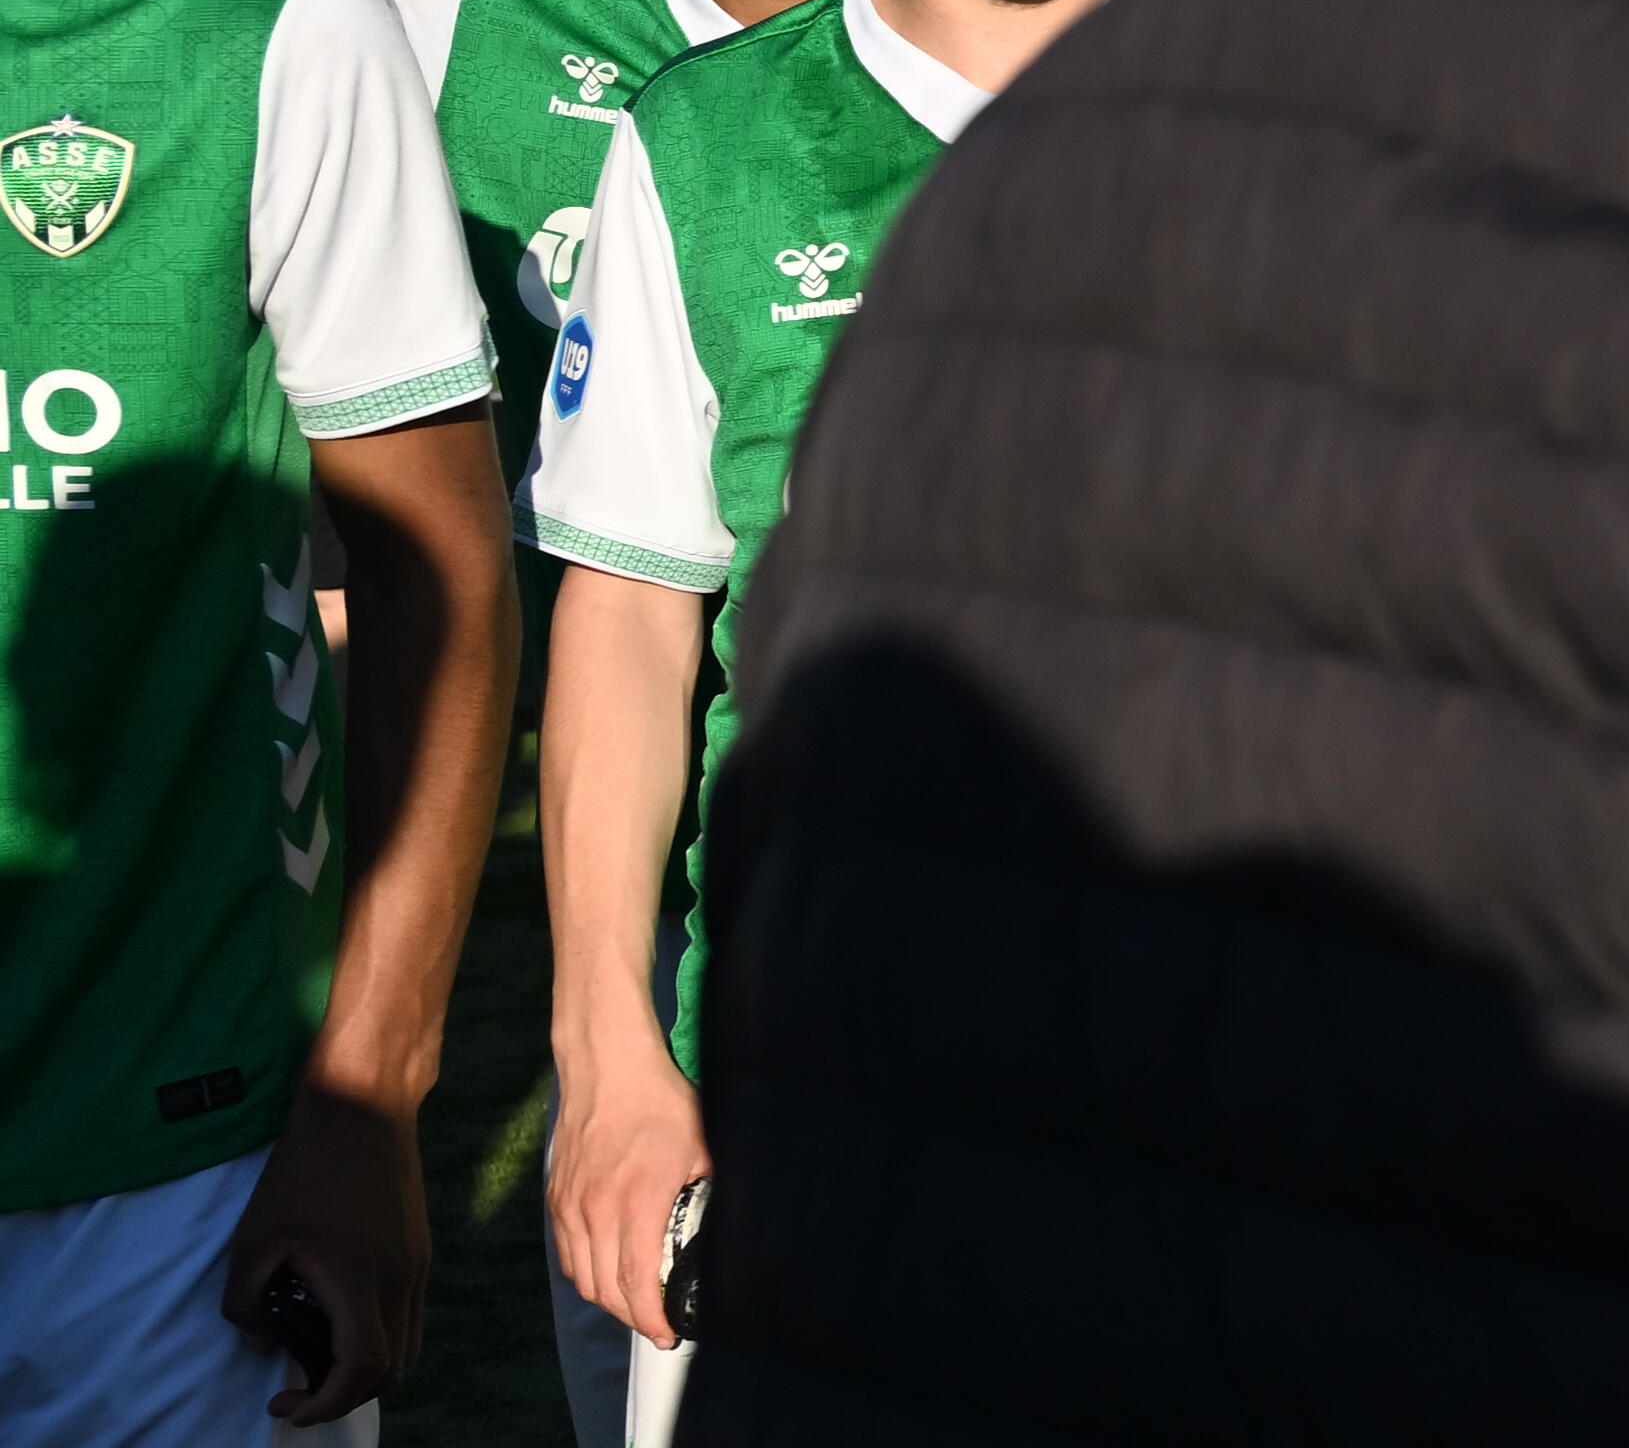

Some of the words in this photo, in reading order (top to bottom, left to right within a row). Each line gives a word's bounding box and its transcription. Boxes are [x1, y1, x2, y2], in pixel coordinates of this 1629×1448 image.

[12, 141, 118, 173] ASSE
[771, 291, 863, 324] hummel
[561, 337, 589, 382] U19
